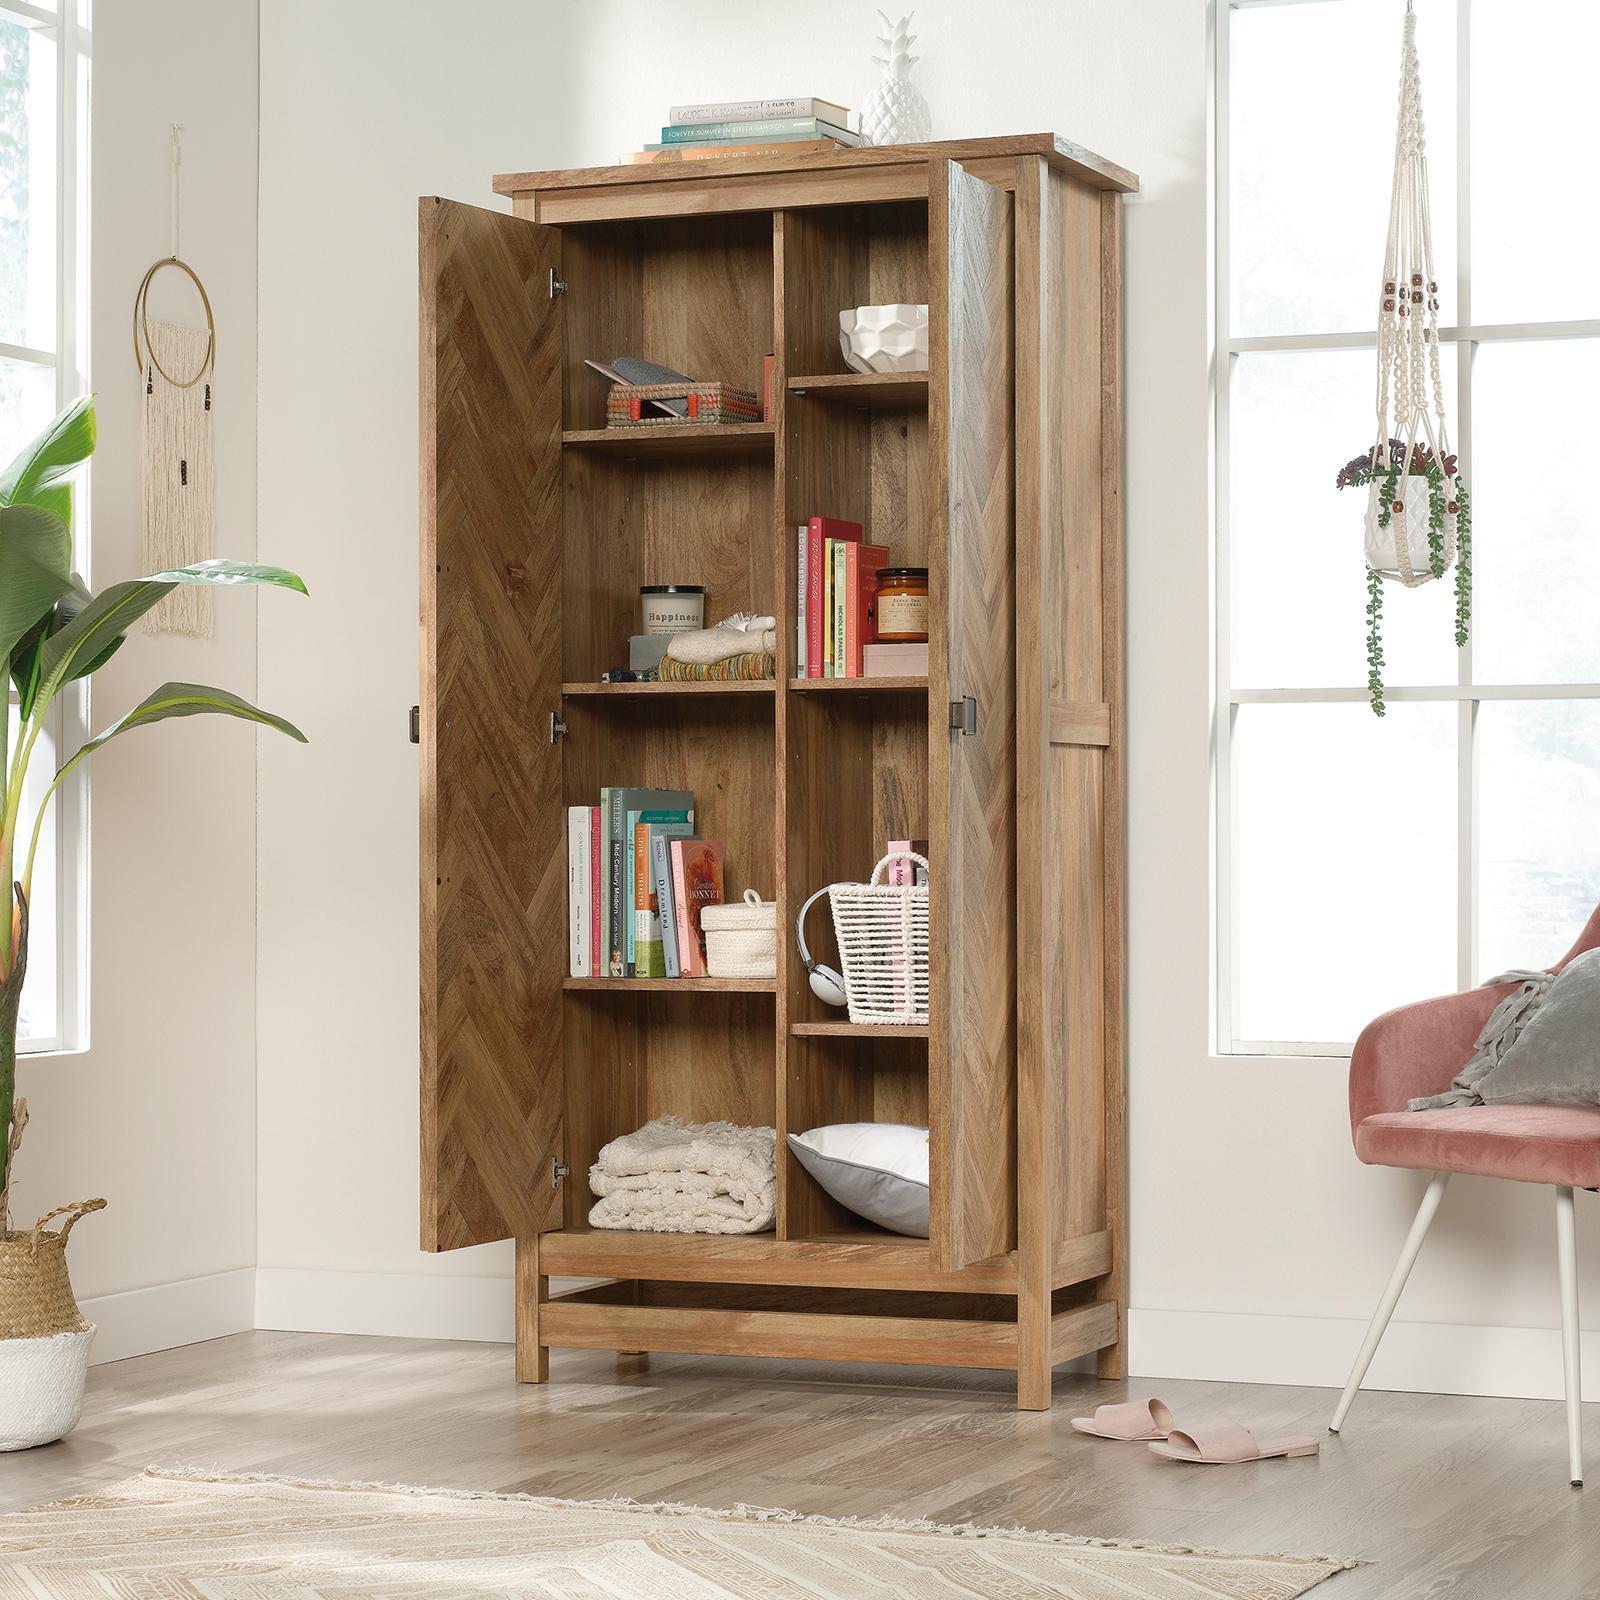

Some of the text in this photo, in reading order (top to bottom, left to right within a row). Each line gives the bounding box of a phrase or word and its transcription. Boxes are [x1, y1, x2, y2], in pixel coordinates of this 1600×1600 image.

[668, 130, 695, 138] FOREVER
[695, 128, 722, 137] SUMMER
[811, 537, 820, 568] RADICAL
[797, 558, 806, 610] EMBROIDERY
[648, 612, 699, 623] Happiness
[612, 796, 622, 834] MILLER'S
[637, 837, 645, 857] LIVING
[613, 843, 621, 914] Mid-Century Modern
[637, 872, 645, 907] STRENGTHS
[689, 889, 720, 899] BONNET
[658, 879, 668, 930] Dreamland
